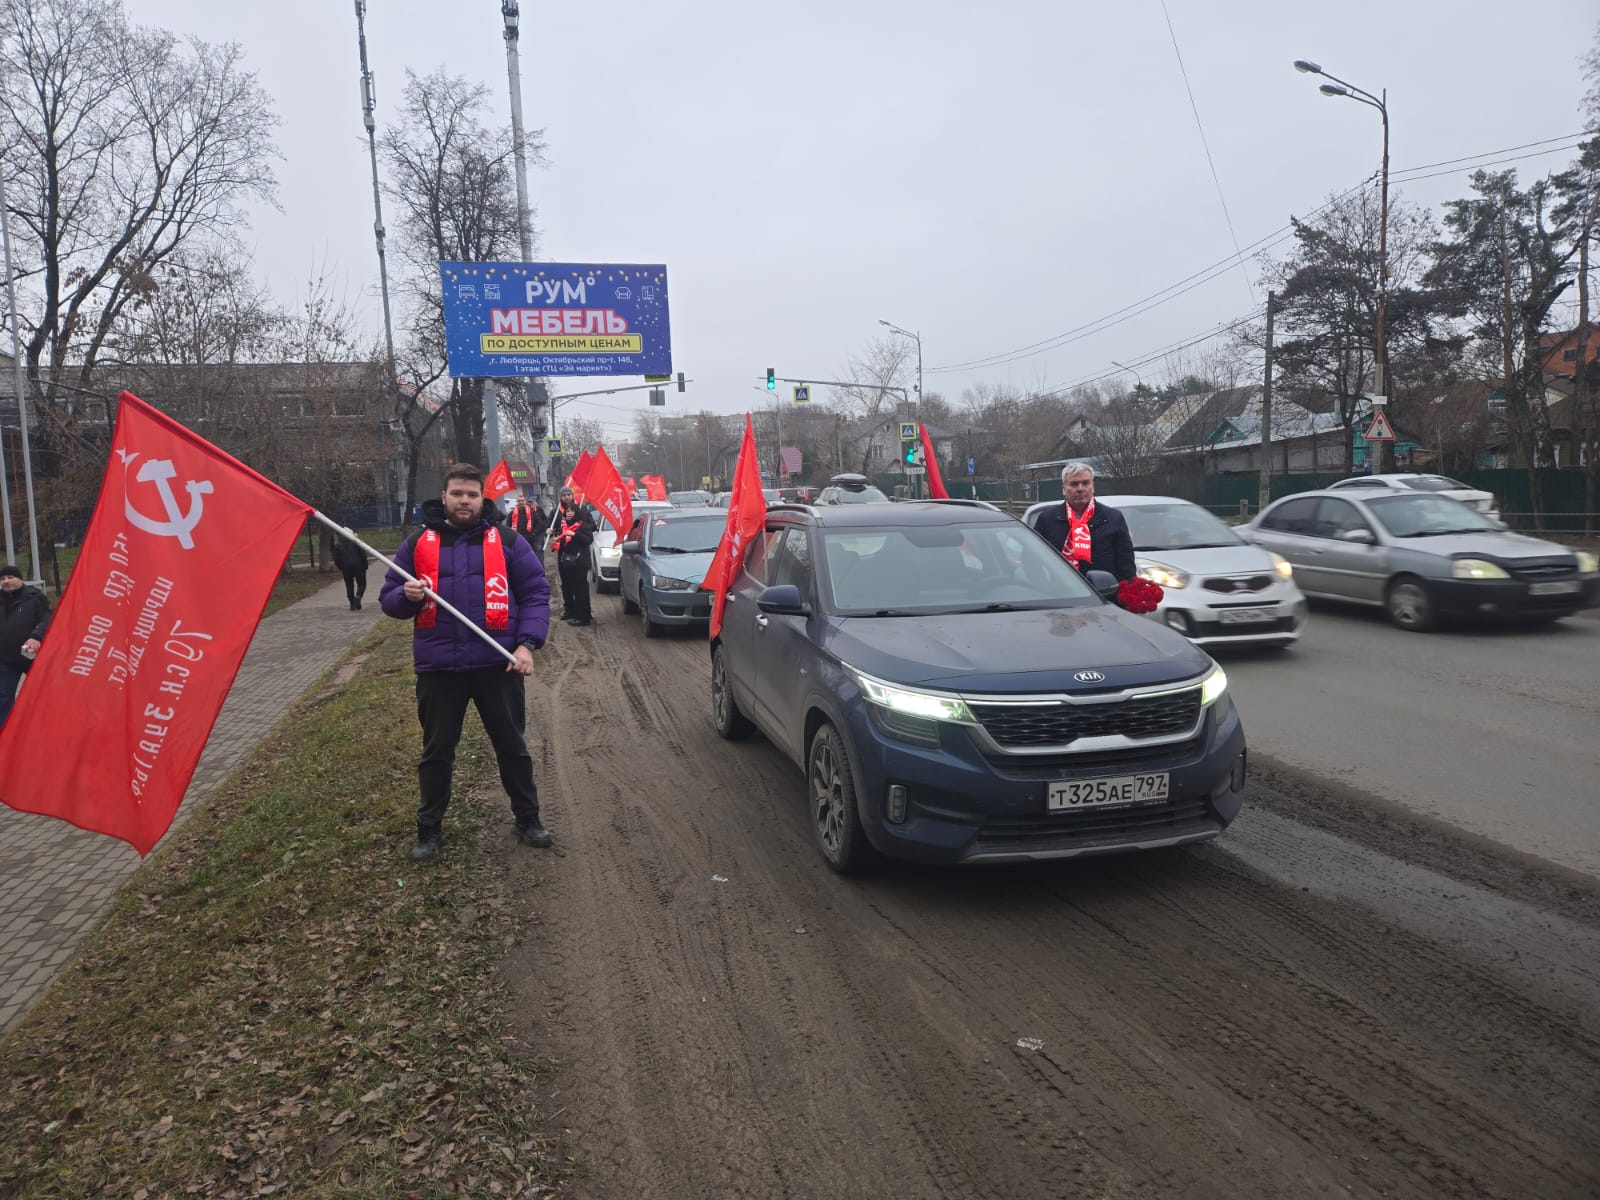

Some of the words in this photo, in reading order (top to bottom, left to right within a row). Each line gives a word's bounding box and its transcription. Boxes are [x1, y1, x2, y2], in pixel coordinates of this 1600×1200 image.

[491, 309, 628, 335] МЕБЕЛЬ
[487, 339, 505, 349] ПО
[508, 339, 587, 350] ДОСТУПНЫМ
[590, 339, 631, 350] ЦЕНАМ
